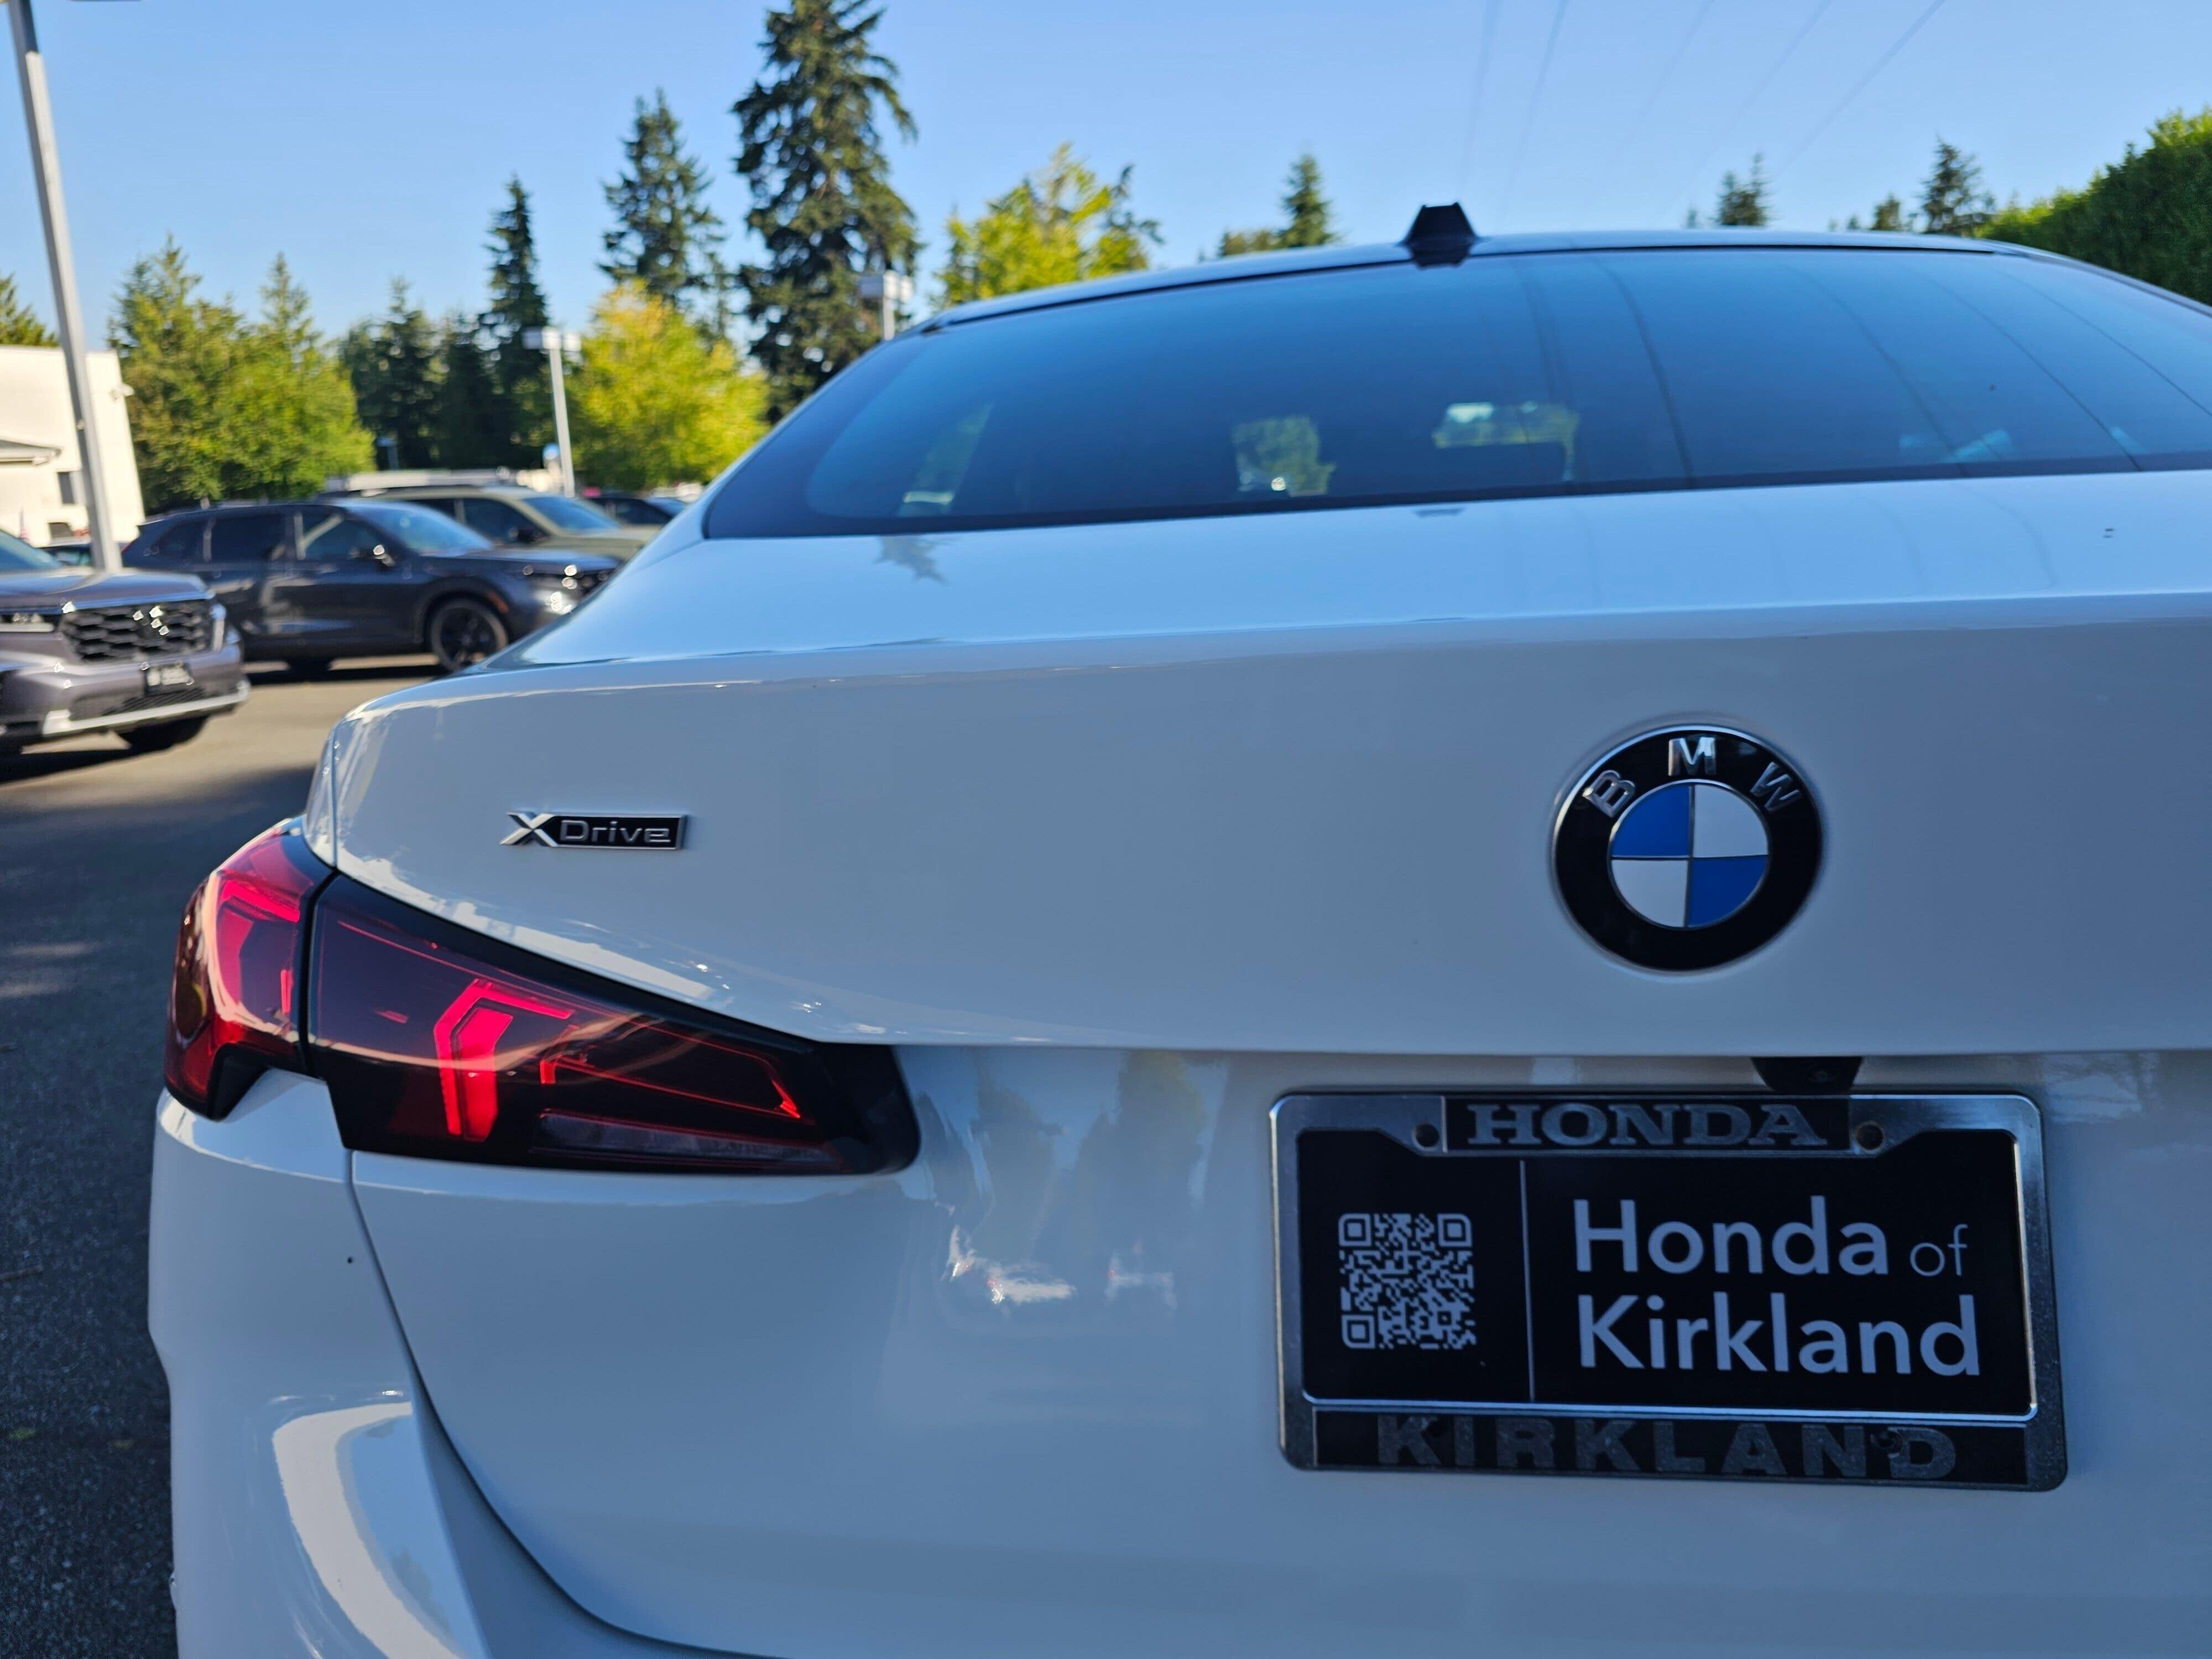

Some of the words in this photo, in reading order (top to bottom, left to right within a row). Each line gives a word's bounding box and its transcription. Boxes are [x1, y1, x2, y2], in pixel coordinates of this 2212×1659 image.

[1582, 736, 1800, 818] BMW
[1467, 1103, 1829, 1149] HONDA
[1573, 1196, 1889, 1276] Honda
[1909, 1224, 1969, 1277] of
[1577, 1291, 1981, 1378] Kirkland
[1376, 1414, 1957, 1480] KIRKLAND
